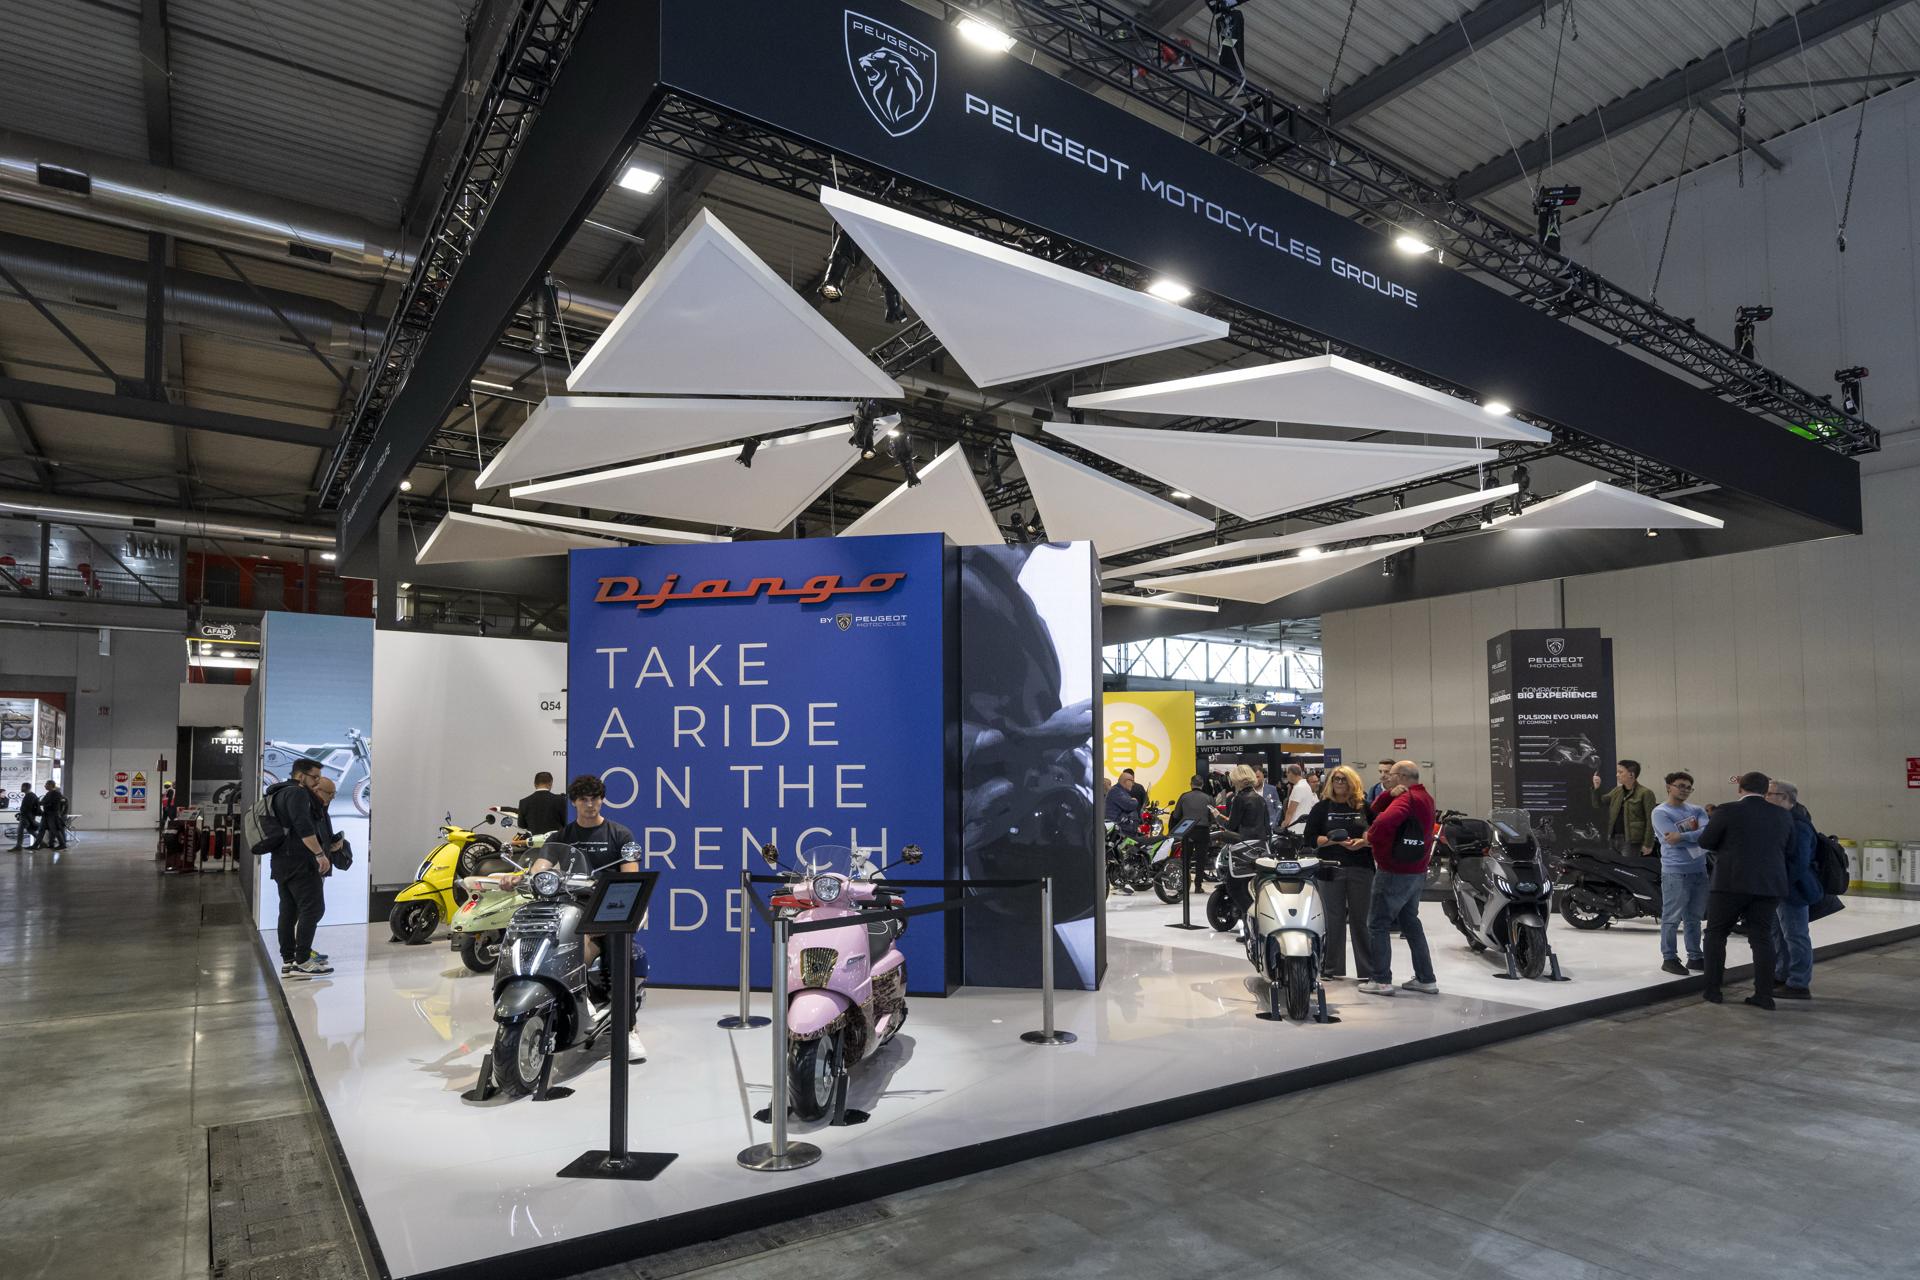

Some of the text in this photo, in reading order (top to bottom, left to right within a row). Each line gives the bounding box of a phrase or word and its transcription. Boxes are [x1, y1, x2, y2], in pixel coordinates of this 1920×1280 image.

[853, 21, 930, 62] PEUGEOT
[965, 92, 1418, 308] PEUGEOT MOTOCYCLES GROUPE
[593, 573, 907, 610] Django
[596, 642, 769, 689] TAKE
[540, 701, 561, 711] Q54
[595, 703, 839, 749] A RIDE
[1206, 730, 1234, 740] KSN
[600, 765, 867, 809] ON THE
[644, 827, 887, 870] RENCH
[1403, 838, 1418, 846] TVS
